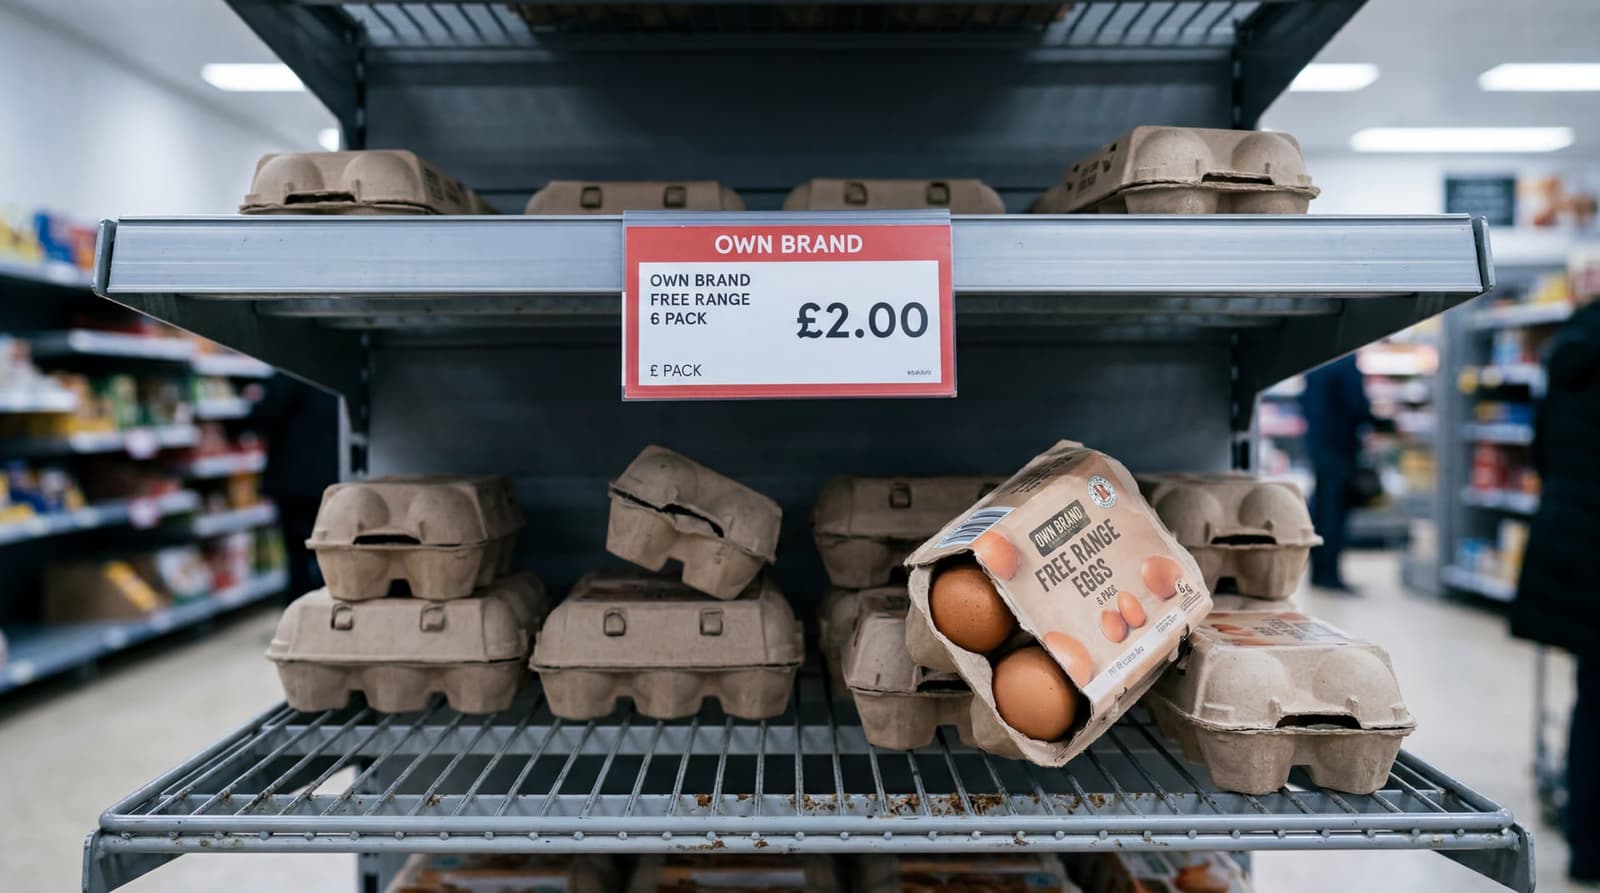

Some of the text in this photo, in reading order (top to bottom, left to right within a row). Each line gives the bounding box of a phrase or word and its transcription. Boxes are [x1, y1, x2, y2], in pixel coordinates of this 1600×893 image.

[714, 234, 863, 255] OWN BRAND
[650, 273, 751, 287] OWN BRAND
[650, 293, 750, 306] FREE RANGE
[650, 312, 707, 325] 6 PACK
[796, 302, 929, 339] £2.00
[650, 364, 702, 377] £ PACK
[1034, 524, 1057, 547] OWN
[1053, 505, 1083, 533] BRAND
[1034, 551, 1077, 592] FREE
[1070, 518, 1121, 565] RANGE
[1071, 558, 1113, 598] EGGS
[1096, 596, 1104, 605] 6
